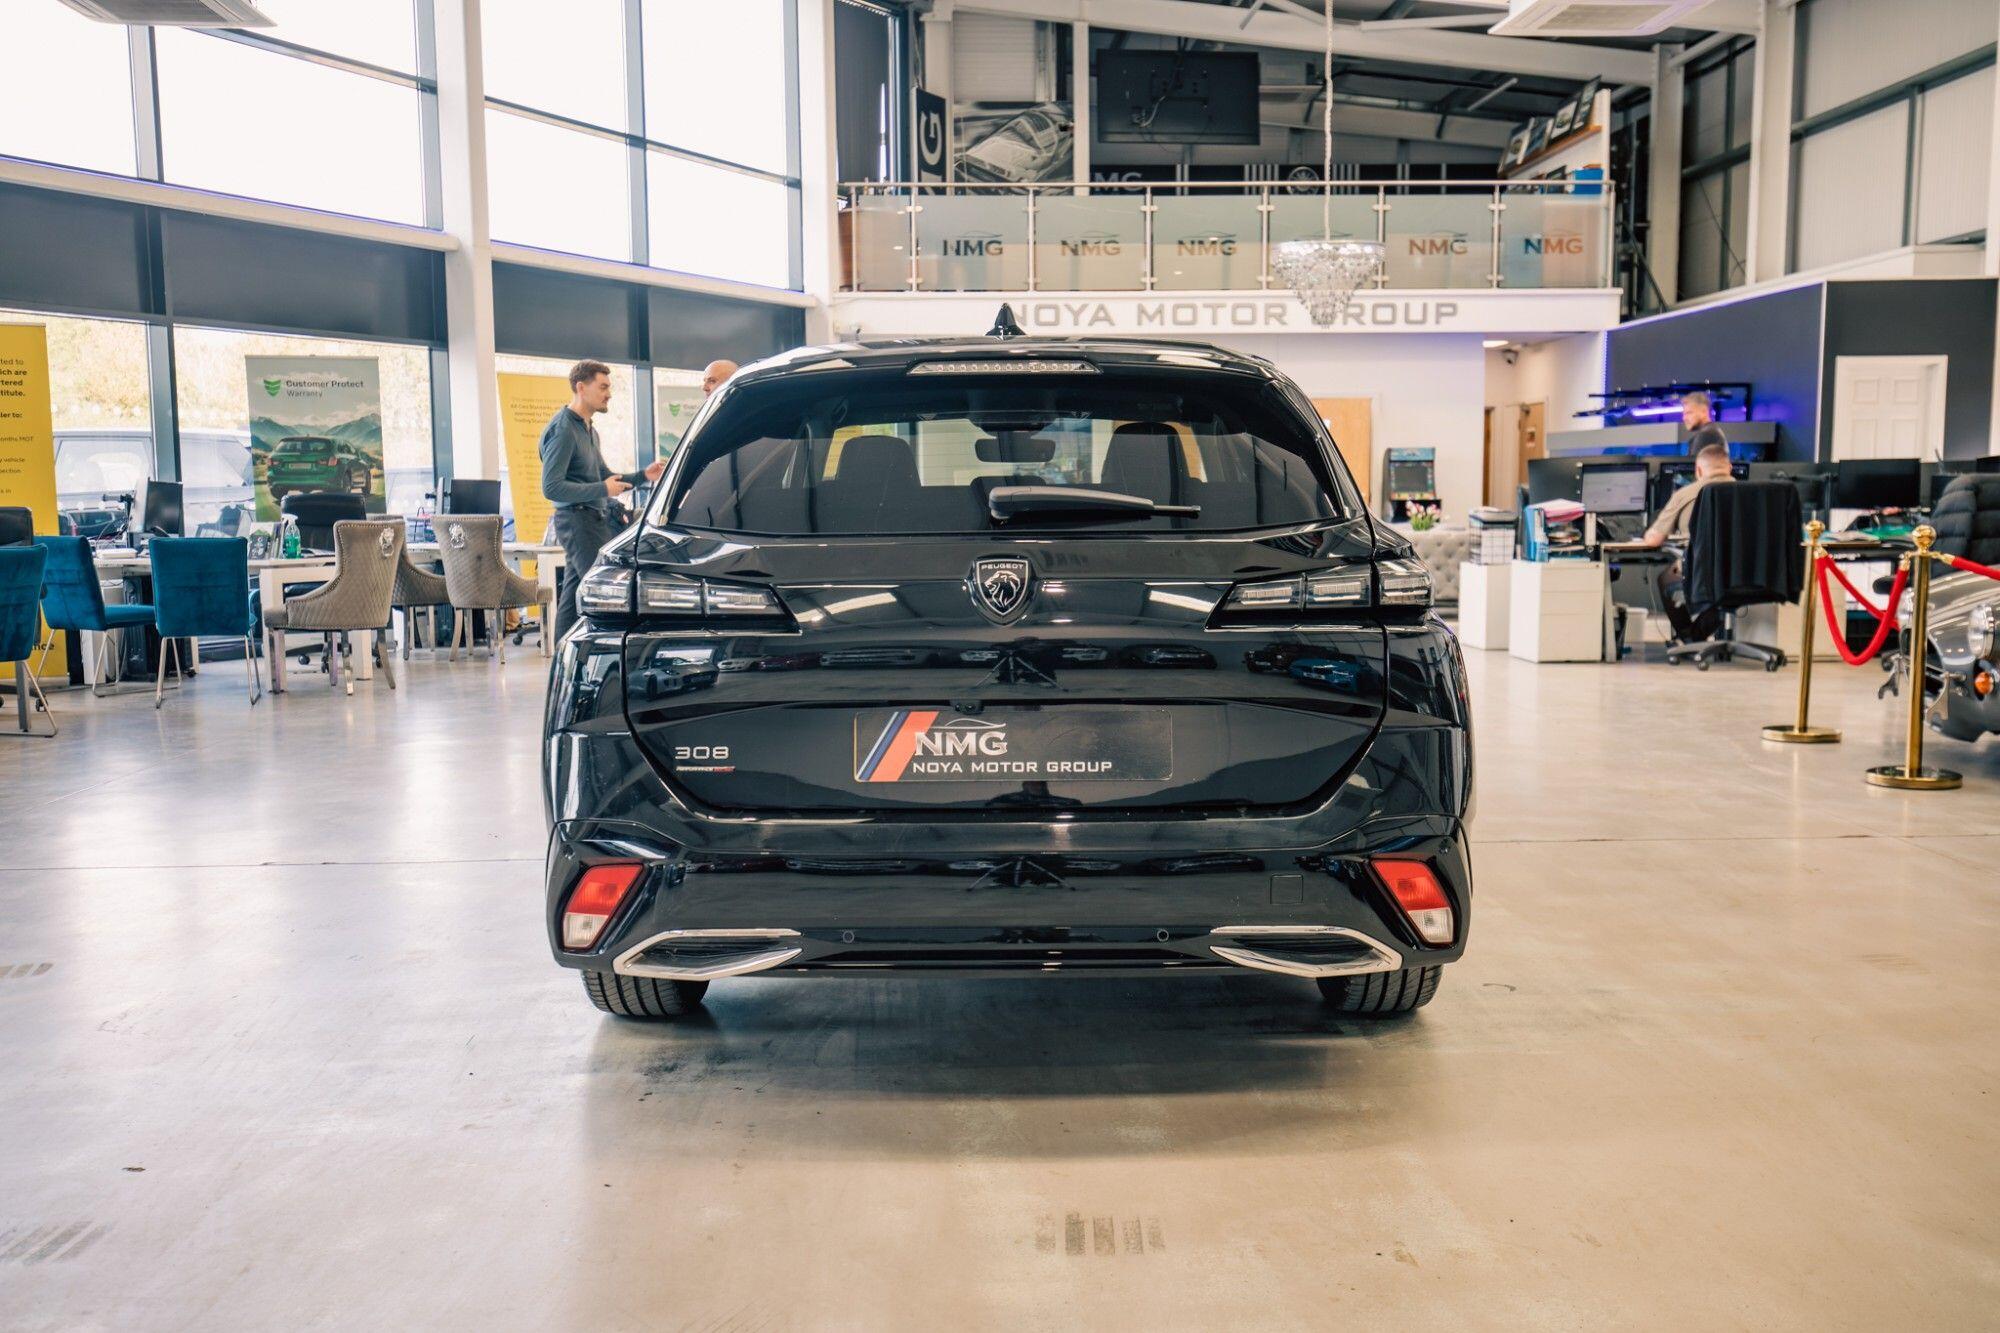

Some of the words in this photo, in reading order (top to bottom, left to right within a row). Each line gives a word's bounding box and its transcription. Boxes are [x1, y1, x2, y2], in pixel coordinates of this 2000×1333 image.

[942, 239, 1004, 257] NMG
[1060, 239, 1121, 257] NMG
[1177, 239, 1237, 257] NMG
[1408, 238, 1468, 255] NMG
[1523, 237, 1583, 255] NMG
[1137, 303, 1288, 326] MOTOR
[286, 380, 329, 388] Customer
[331, 379, 365, 388] Protect
[286, 389, 323, 397] Warranty
[980, 562, 1025, 571] PEUGEOT
[914, 731, 1008, 756] NMG
[674, 746, 730, 760] 308
[912, 761, 964, 773] NOYA
[971, 761, 1038, 773] MOTOR
[1046, 761, 1113, 773] GROUP
